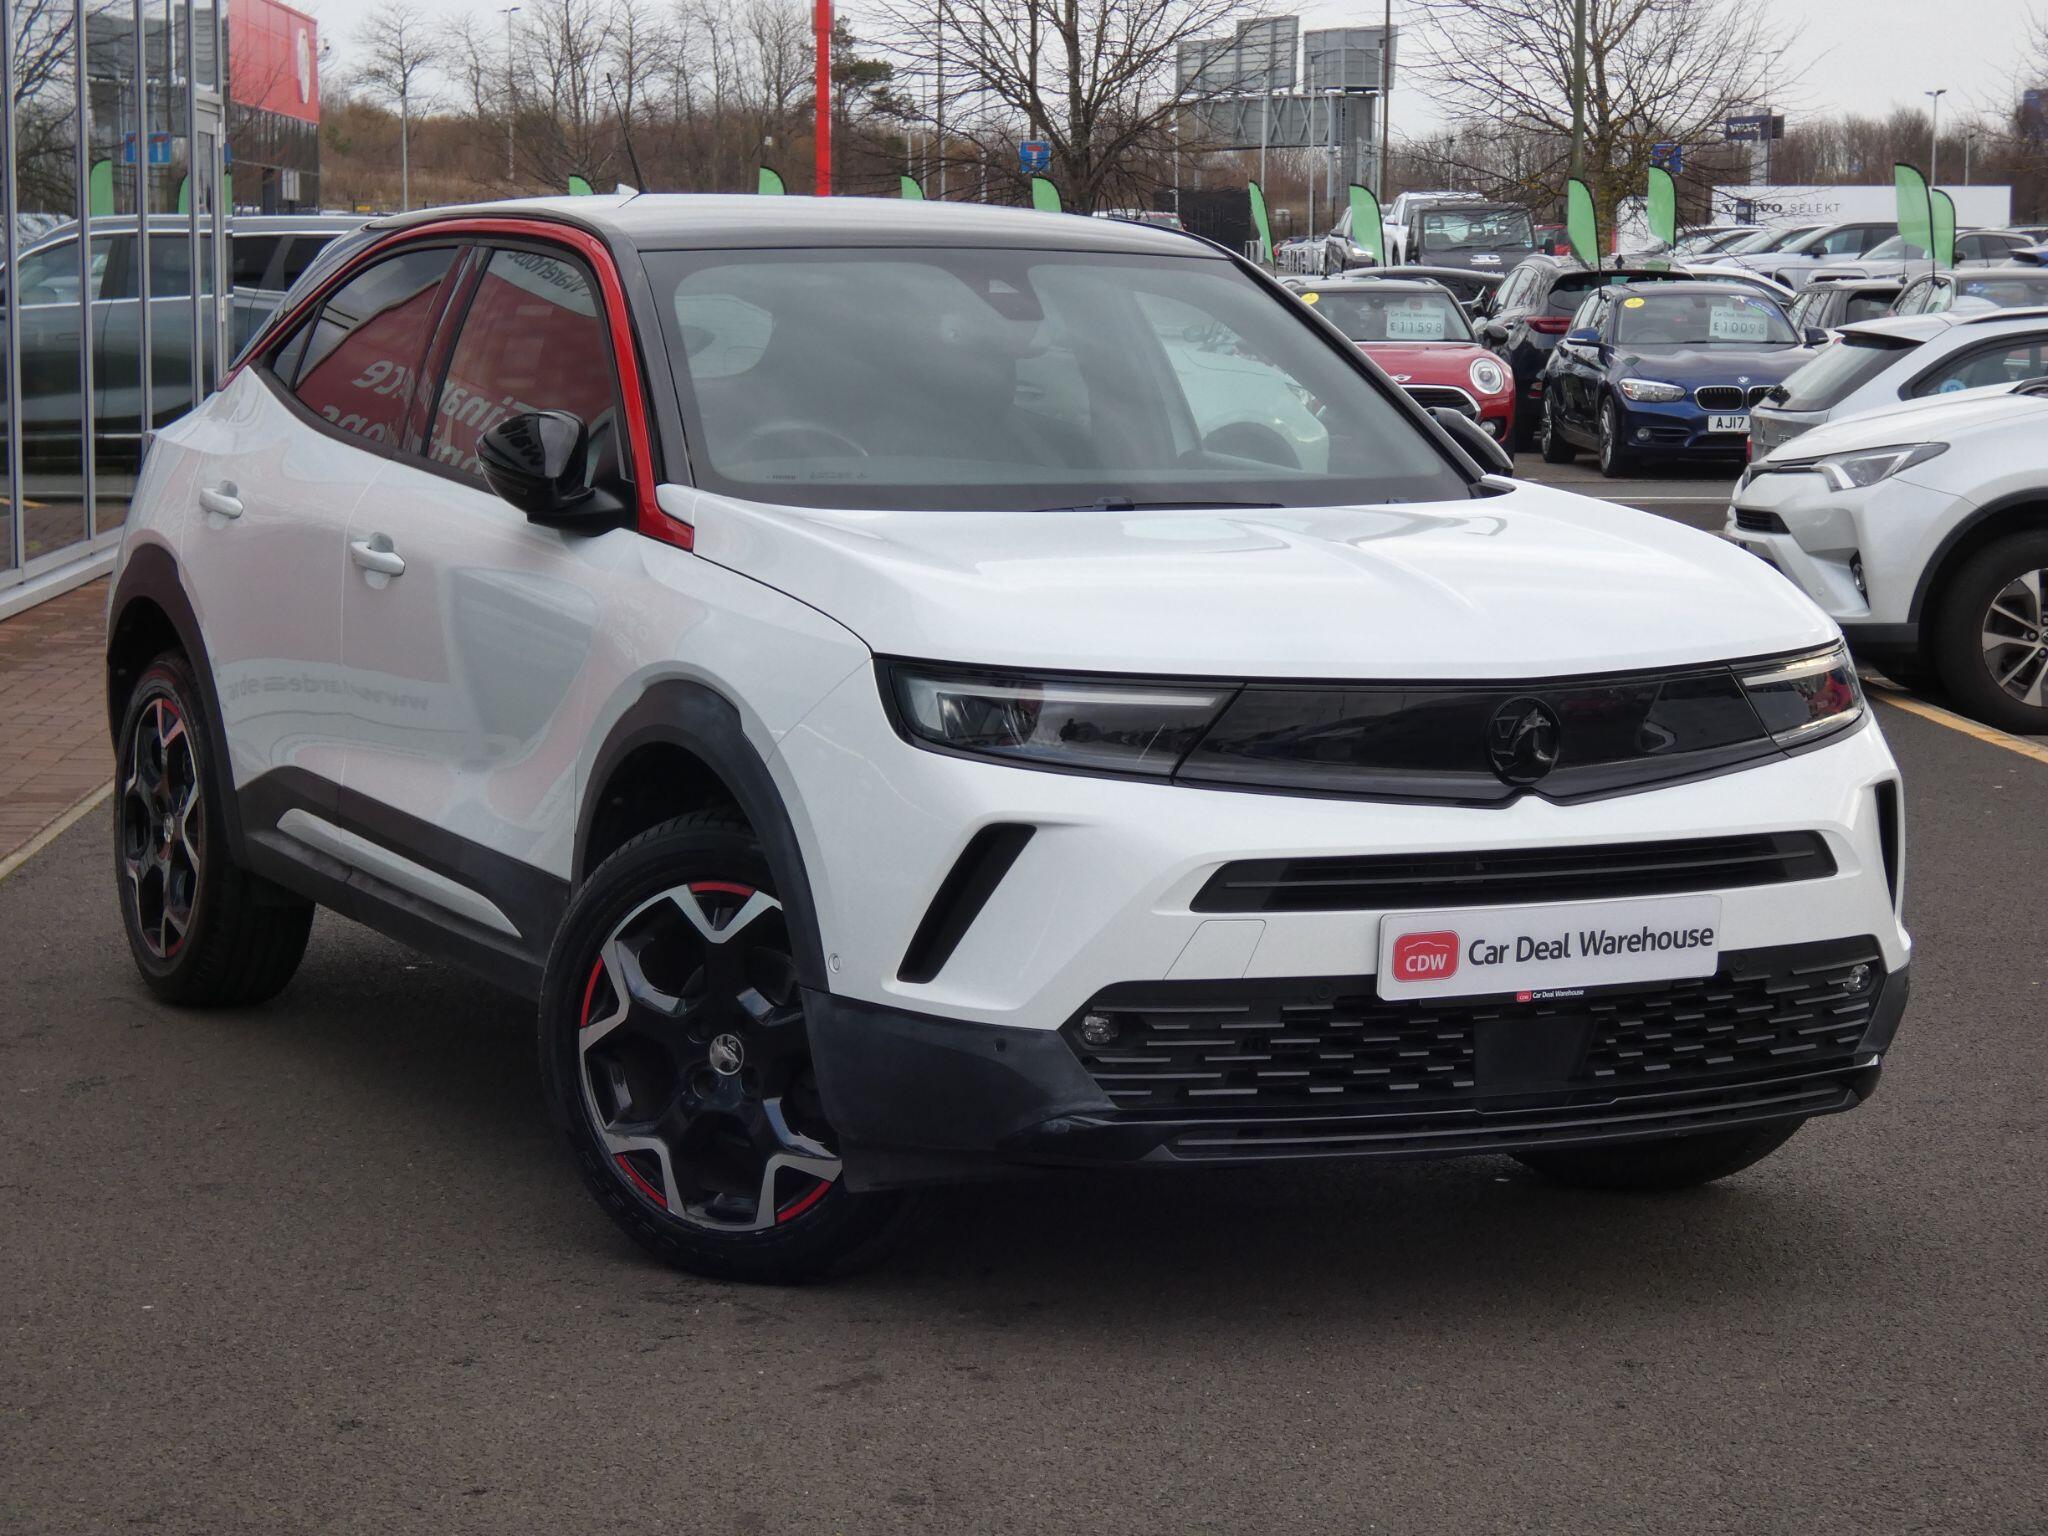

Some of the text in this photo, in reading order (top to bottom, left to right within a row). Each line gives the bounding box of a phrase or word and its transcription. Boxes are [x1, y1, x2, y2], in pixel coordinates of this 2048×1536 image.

[1722, 202, 1841, 213] VVO SELEKT
[1390, 321, 1442, 333] £11598
[1713, 321, 1765, 334] £10098
[1716, 416, 1745, 429] AJ17
[1468, 926, 1715, 966] Car Deal Warehouse
[1405, 953, 1447, 973] CDW
[1555, 989, 1584, 997] Warehouse
